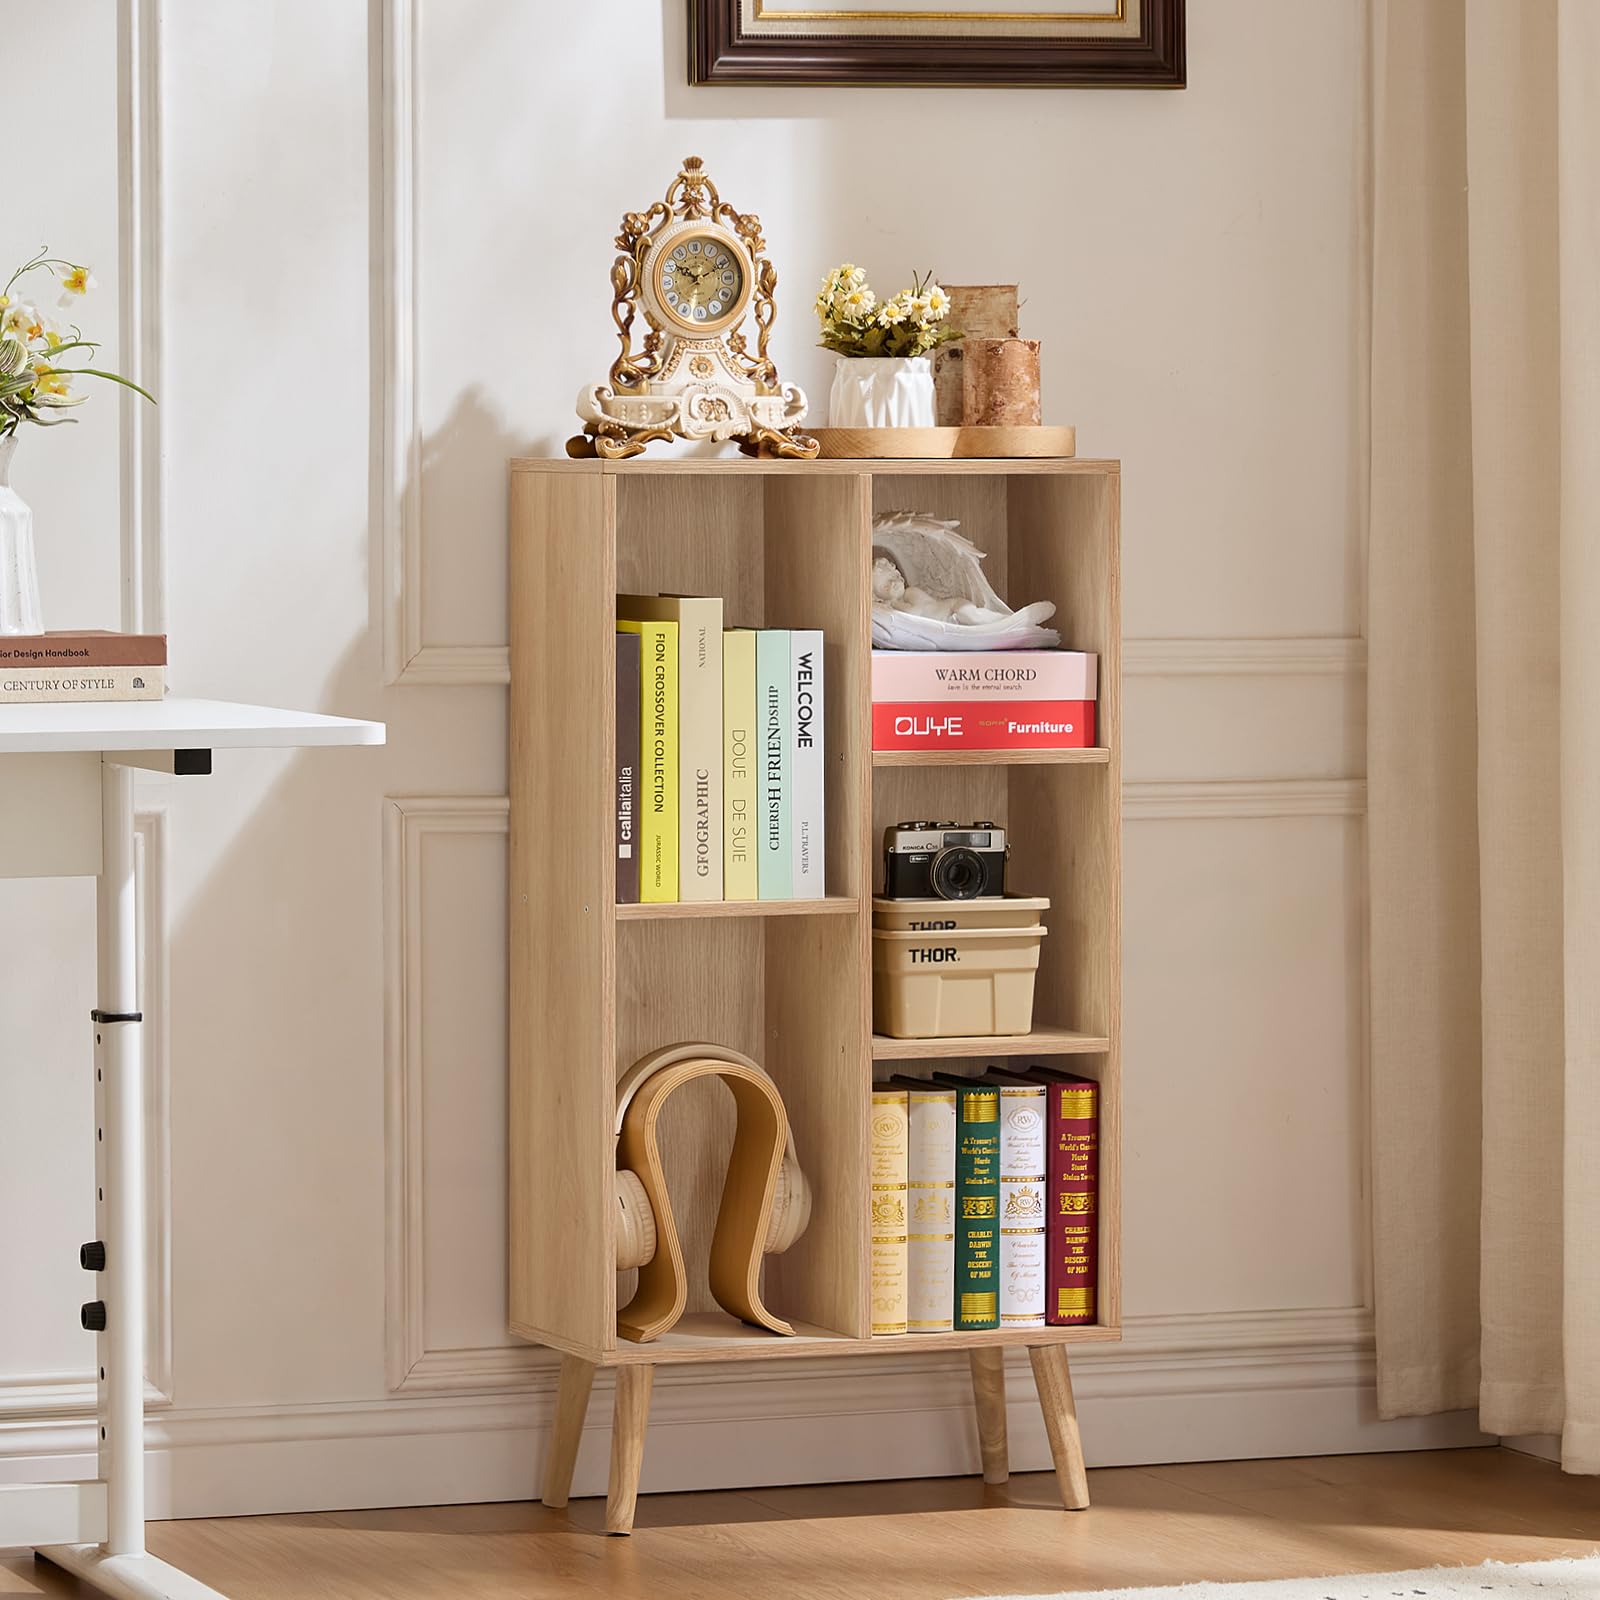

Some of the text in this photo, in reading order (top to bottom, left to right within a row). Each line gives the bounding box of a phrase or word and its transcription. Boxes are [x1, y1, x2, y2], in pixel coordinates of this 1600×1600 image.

[14, 649, 43, 660] Design
[45, 648, 90, 658] Handbook
[935, 668, 1037, 682] WARM CHORD
[3, 678, 115, 692] CENTURY OF STYLE
[798, 652, 813, 748] WELCOME
[654, 633, 666, 813] FION CROSSOVER COLLECTION
[1007, 720, 1074, 734] Furniture
[768, 685, 782, 851] CHERISH FRIENDSHIP
[732, 729, 747, 862] DOUE DE SUIE
[618, 766, 633, 841] caliaitalia
[908, 947, 961, 964] THOR.
[1061, 1133, 1067, 1141] A
[1067, 1133, 1090, 1142] Treasury
[974, 1250, 987, 1259] THE
[1071, 1246, 1084, 1254] THE
[969, 1271, 978, 1279] OF
[1067, 1266, 1075, 1274] OF
